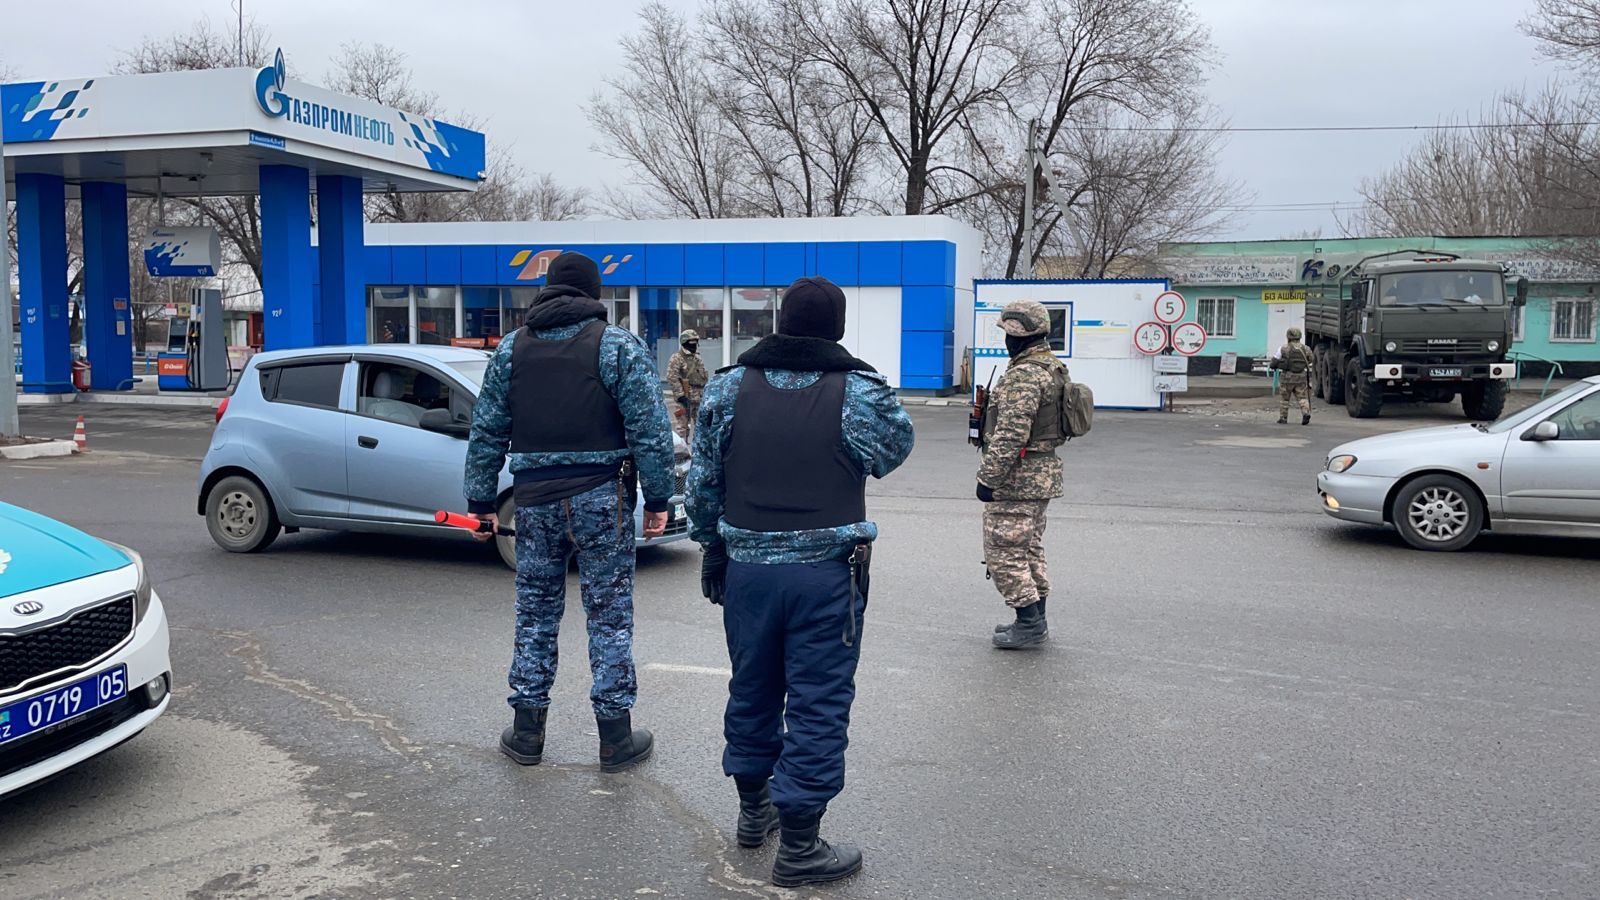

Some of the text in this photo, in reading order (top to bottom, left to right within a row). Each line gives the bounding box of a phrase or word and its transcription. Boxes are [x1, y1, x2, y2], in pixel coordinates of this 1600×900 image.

[286, 96, 395, 146] ГАЗПРОМНЕФТЬ
[153, 267, 160, 275] 2
[1264, 292, 1276, 301] БІЗ
[1165, 302, 1175, 315] 5
[17, 602, 42, 614] KIA
[28, 687, 82, 727] 0719
[100, 669, 124, 700] 05
